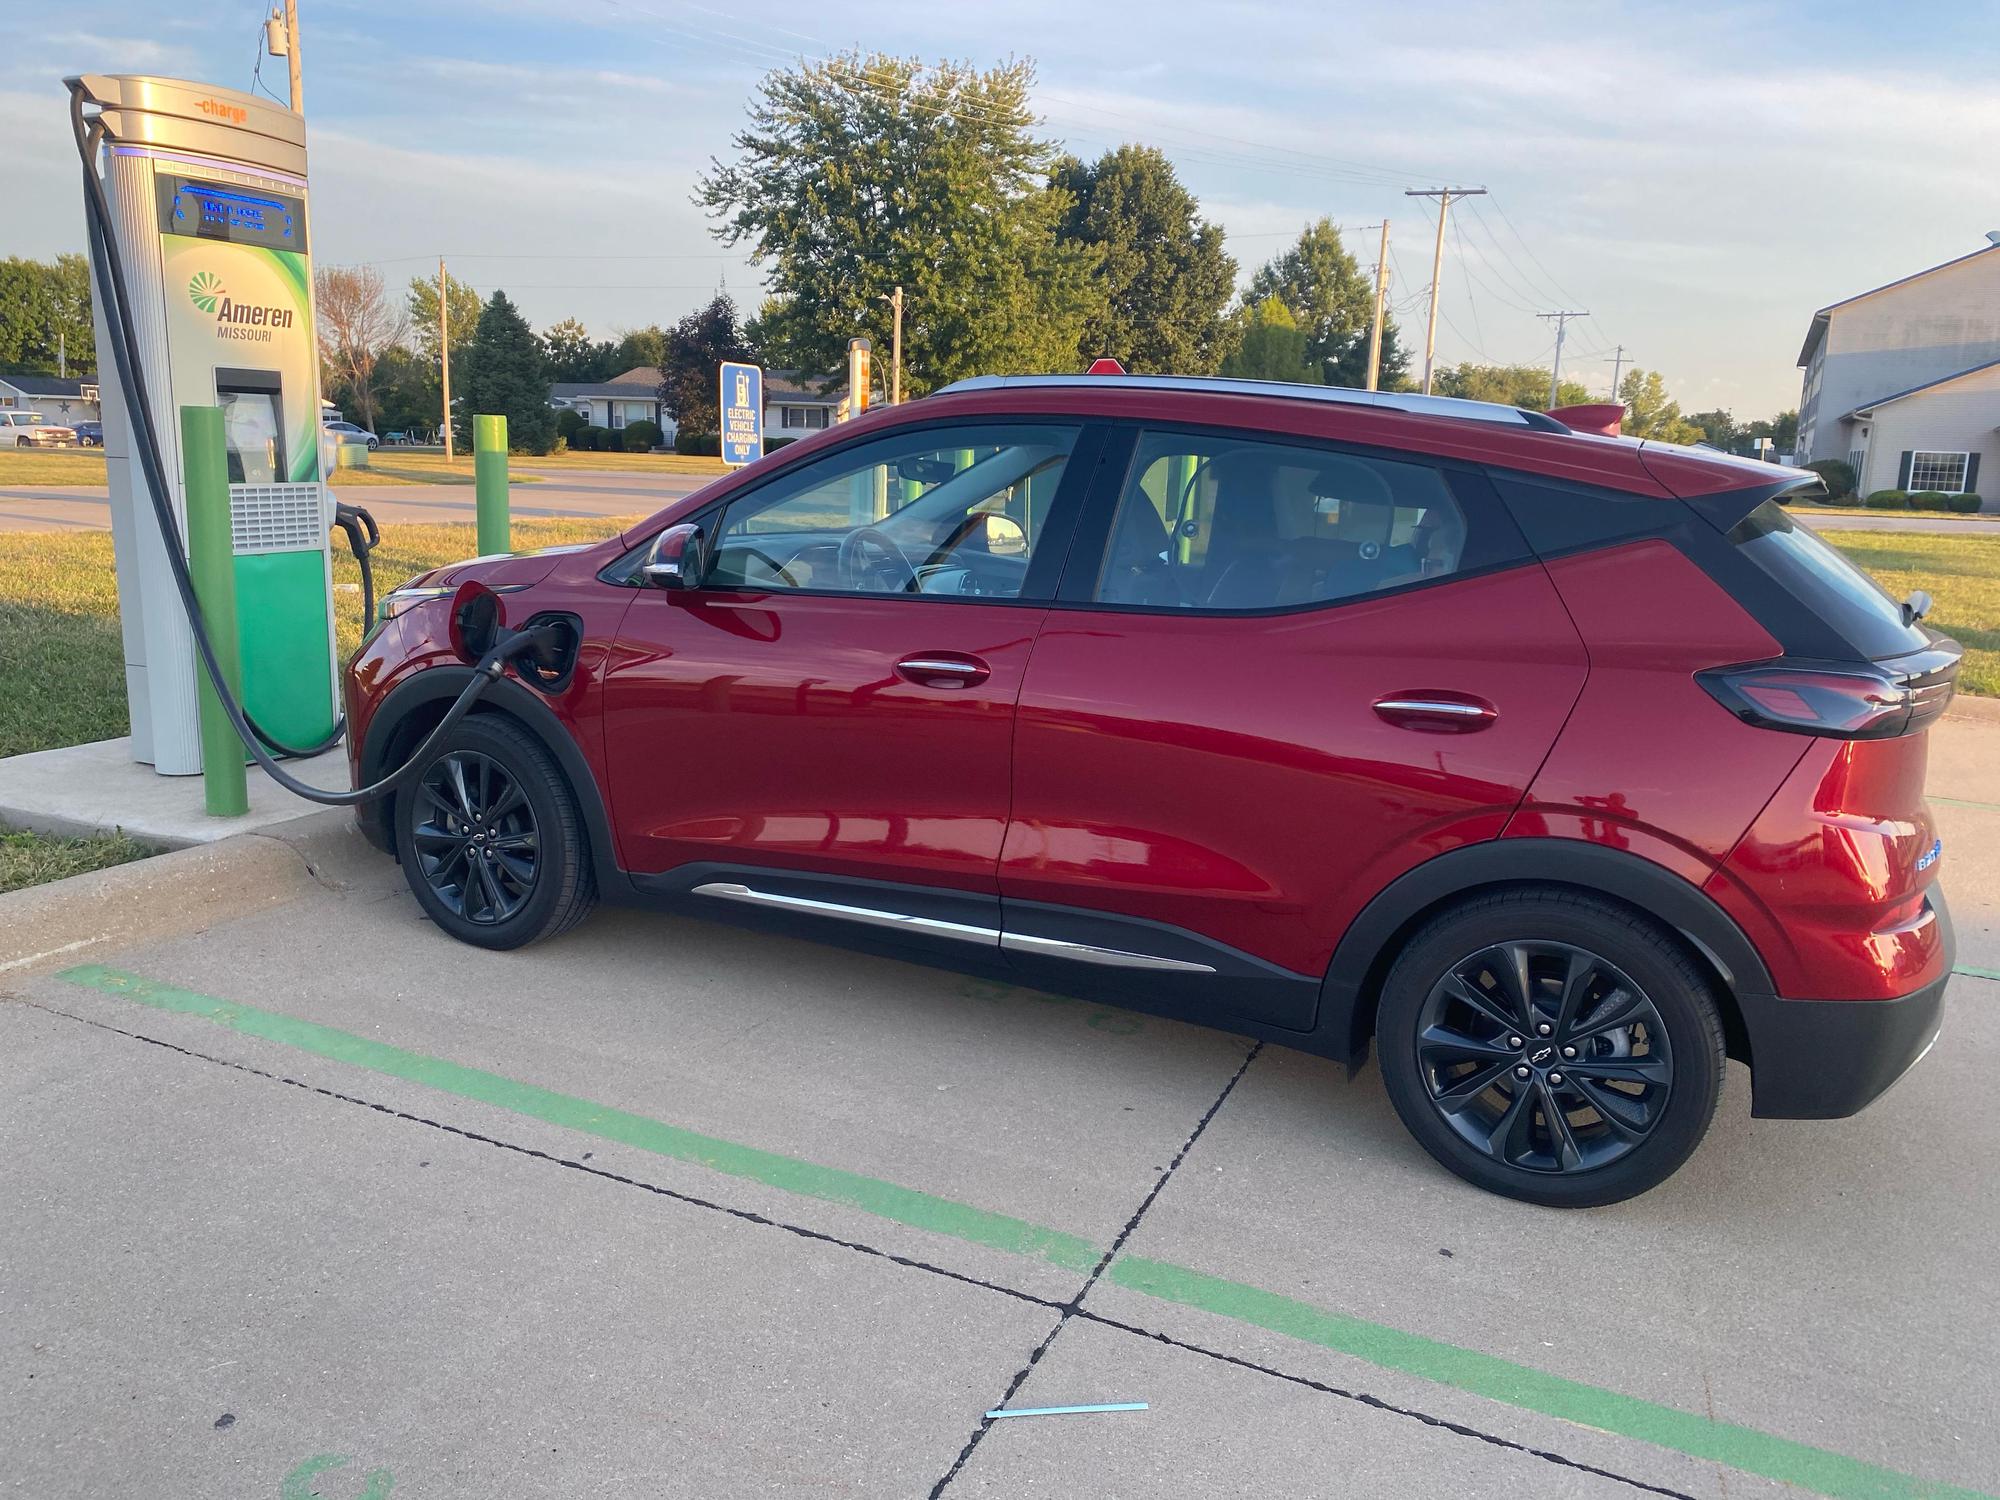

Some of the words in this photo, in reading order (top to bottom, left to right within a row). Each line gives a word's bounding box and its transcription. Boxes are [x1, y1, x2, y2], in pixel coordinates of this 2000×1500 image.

[217, 297, 293, 328] Ameren
[217, 327, 272, 342] MISSOURI
[728, 408, 756, 420] ELECTRIC
[730, 420, 754, 432] VEHICLE
[727, 432, 758, 444] CHARGING
[735, 444, 751, 455] ONLY
